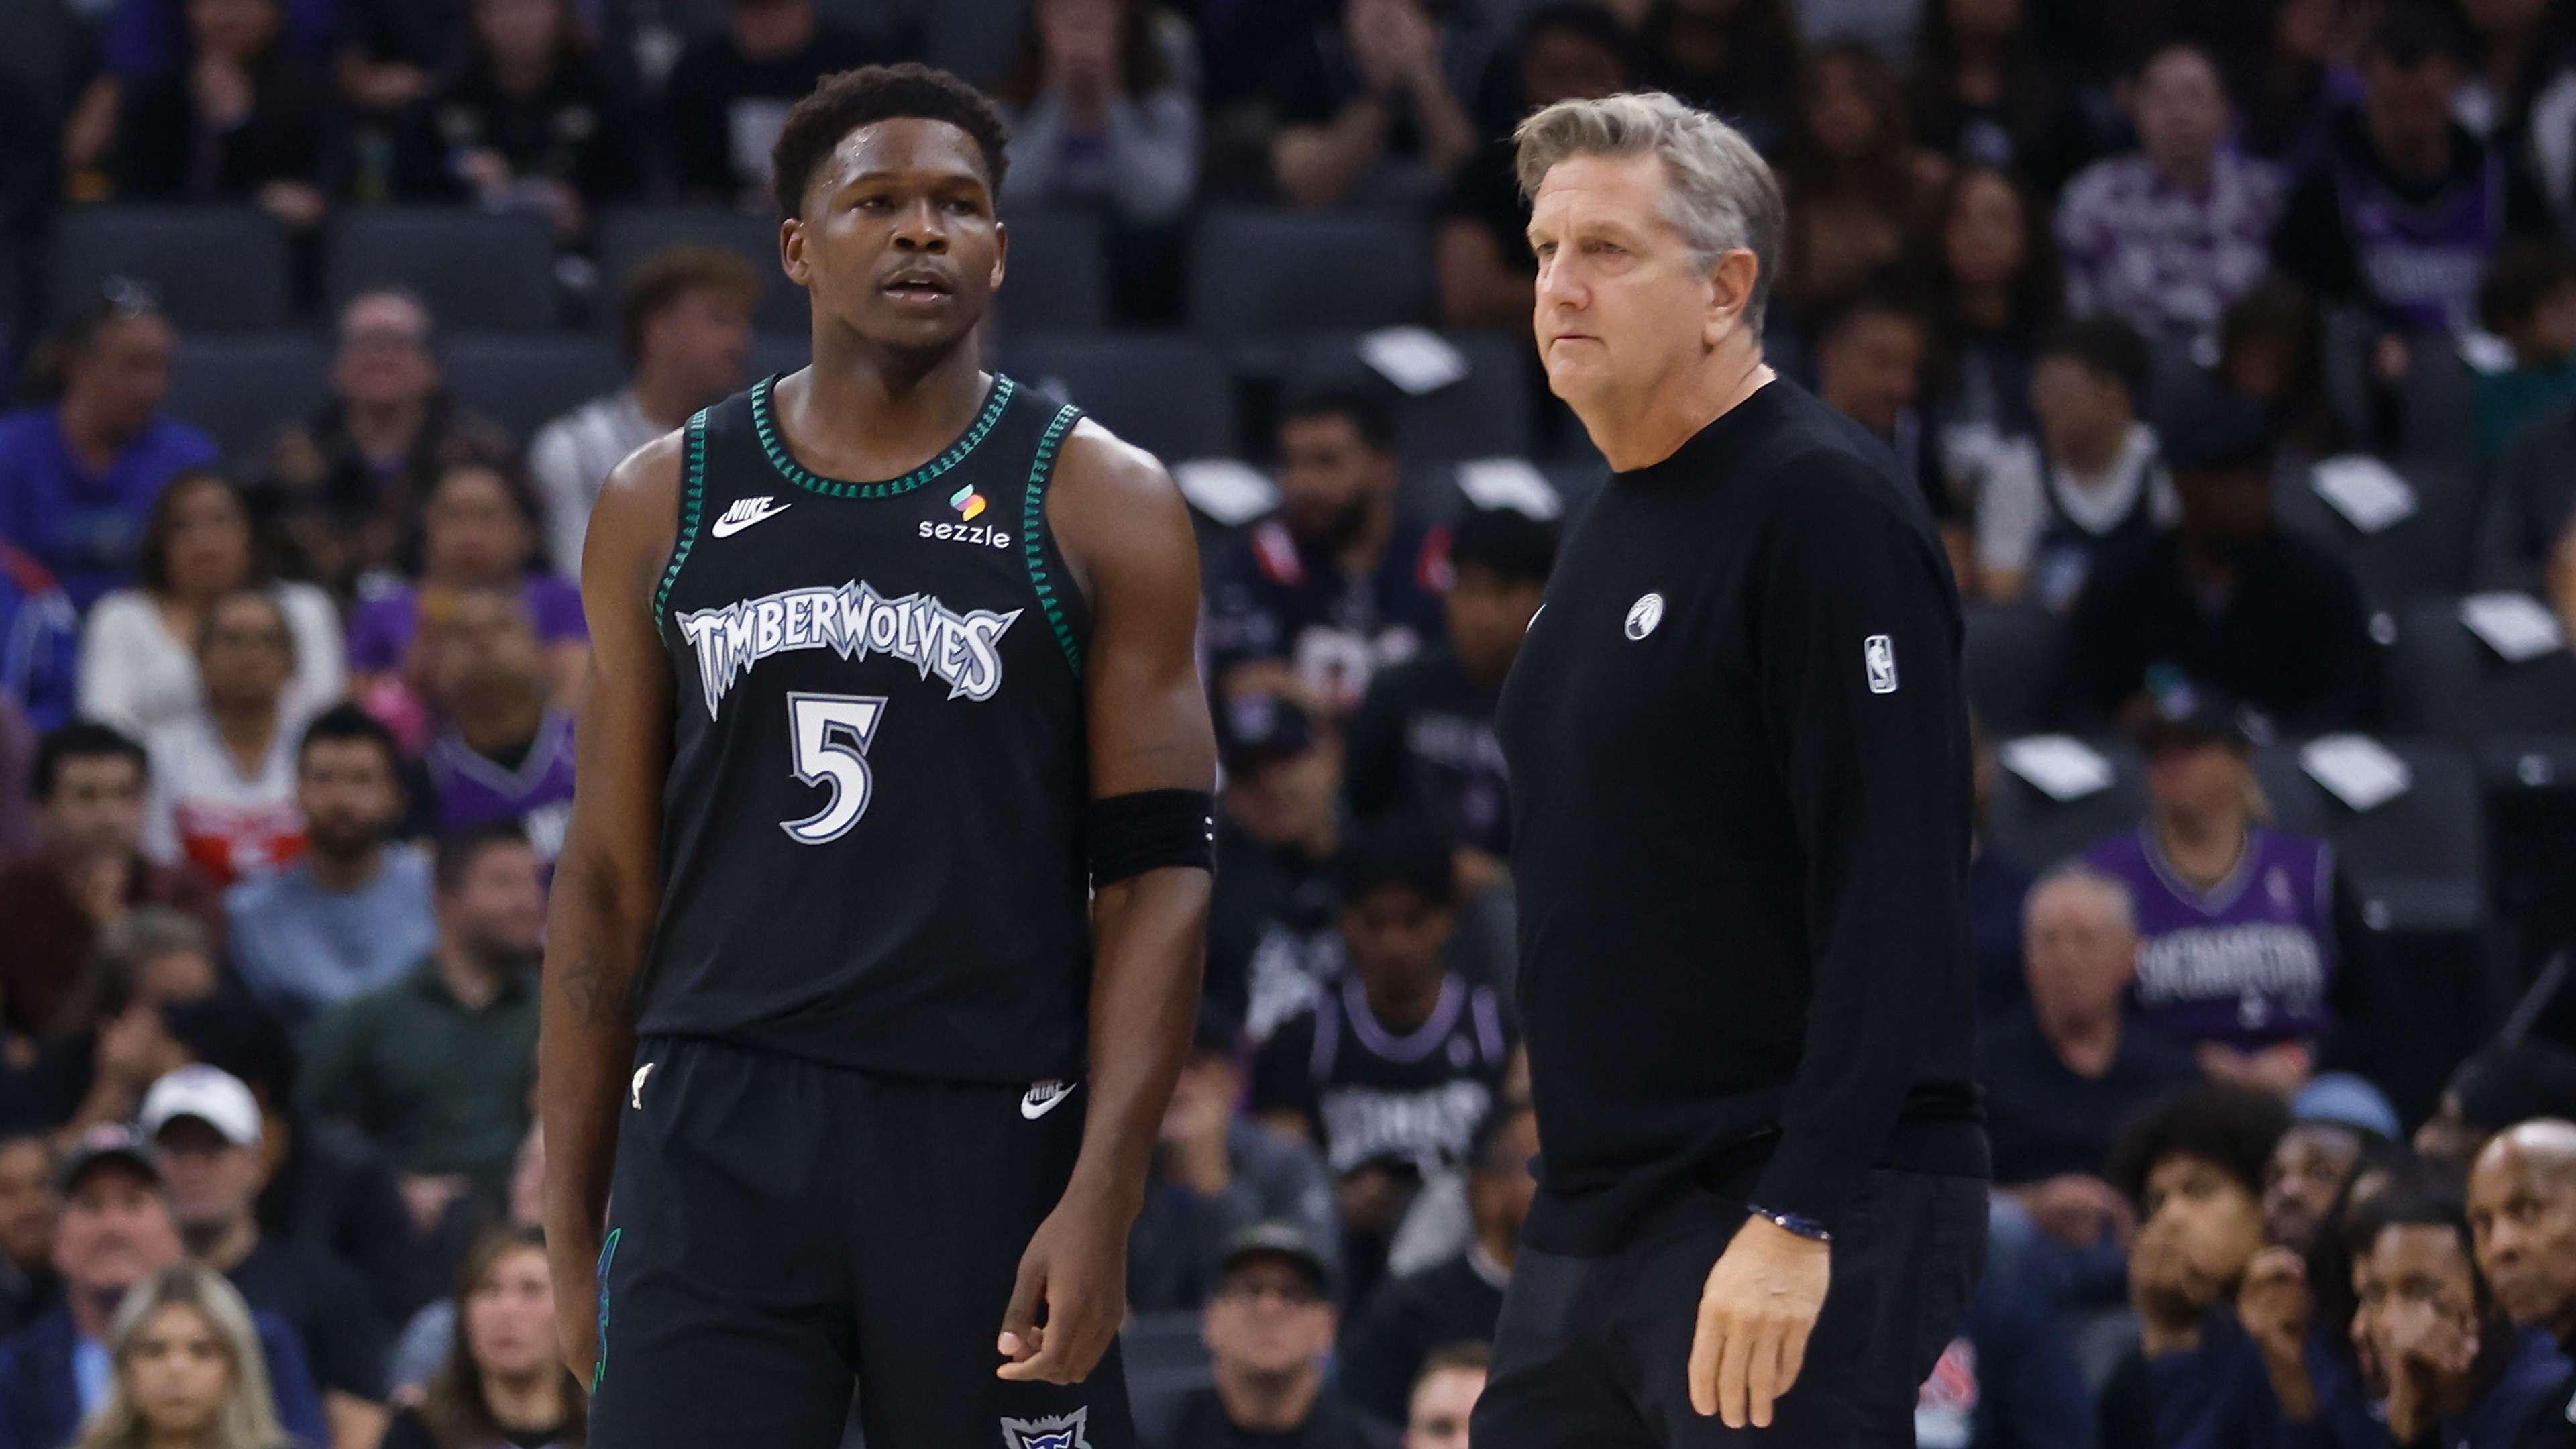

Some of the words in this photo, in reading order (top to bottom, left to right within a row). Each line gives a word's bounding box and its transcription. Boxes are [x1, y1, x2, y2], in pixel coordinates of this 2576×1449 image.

[724, 496, 774, 522] NIKE
[918, 521, 1010, 549] sezzle
[675, 578, 1025, 723] TIMBERWOLVES
[779, 691, 889, 845] 5
[1030, 1079, 1063, 1101] NIKE
